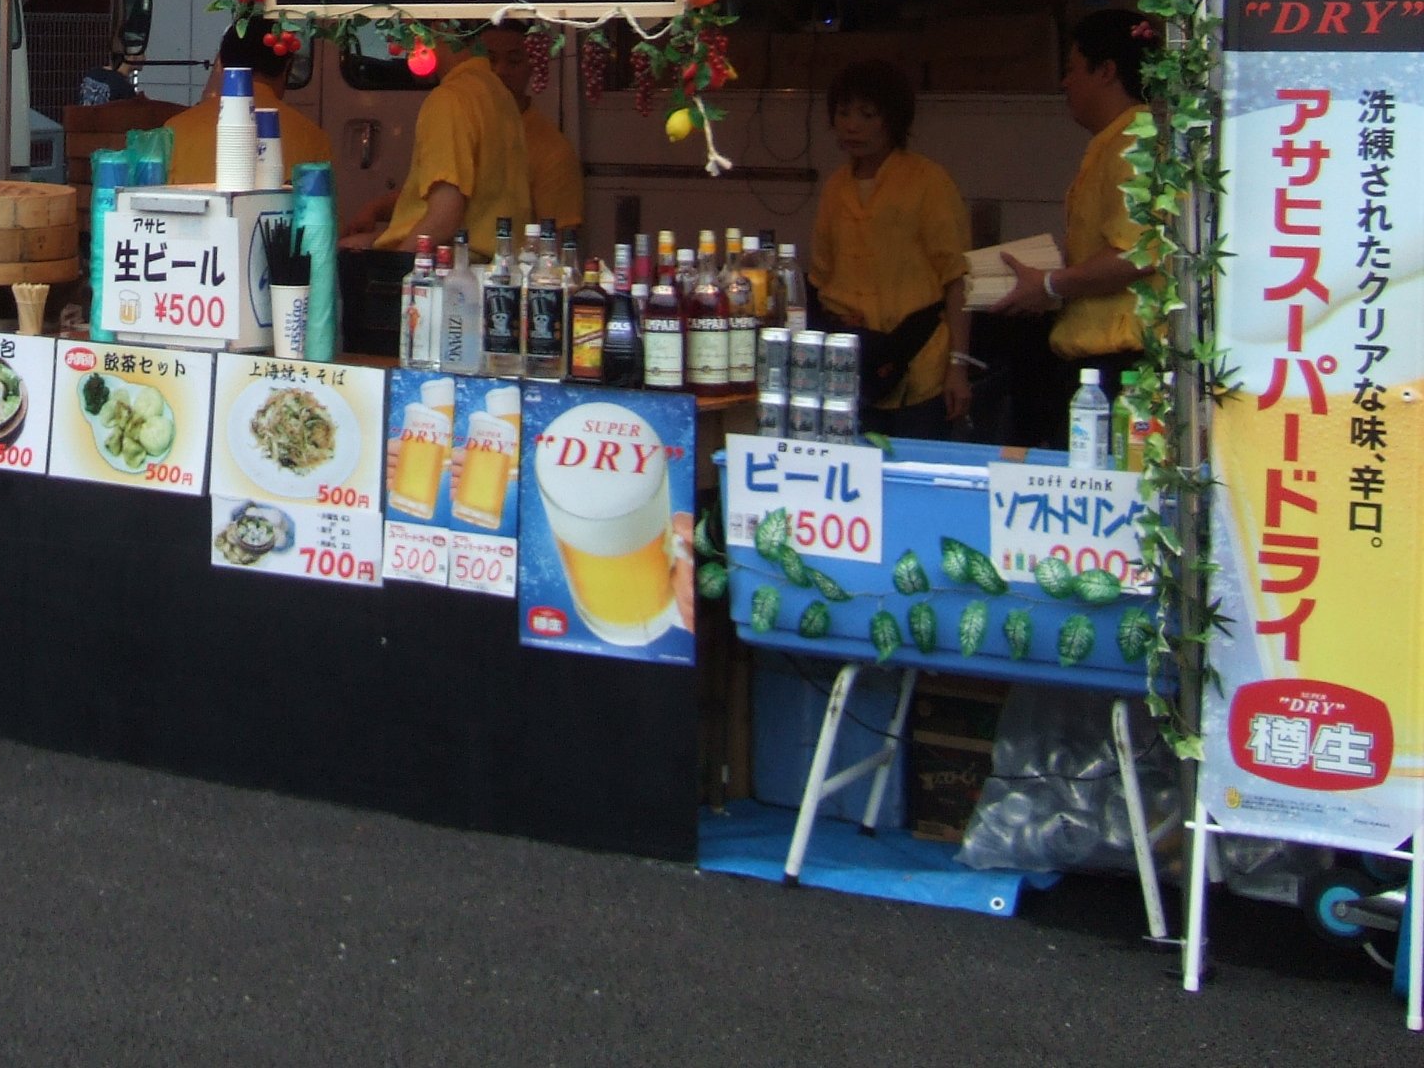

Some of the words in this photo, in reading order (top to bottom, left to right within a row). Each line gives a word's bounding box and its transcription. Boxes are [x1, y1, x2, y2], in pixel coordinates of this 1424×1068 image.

[132, 218, 166, 234] アサヒ
[114, 239, 226, 287] 生ビール
[154, 292, 226, 329] ¥500
[1348, 89, 1396, 549] 洗練されたクリアな味、辛口。
[103, 352, 187, 377] 飲茶セット
[248, 362, 348, 387] 上海焼きそば
[1255, 89, 1338, 662] アサヒスーパードライ
[582, 420, 642, 437] SUPER
[145, 463, 194, 486] 500円
[745, 451, 861, 503] ビール
[1028, 474, 1062, 488] soft
[1070, 478, 1113, 492] drink
[316, 483, 370, 509] 500円
[785, 509, 872, 553] 500
[299, 547, 375, 581] 700円
[1245, 713, 1375, 778] 樽生
